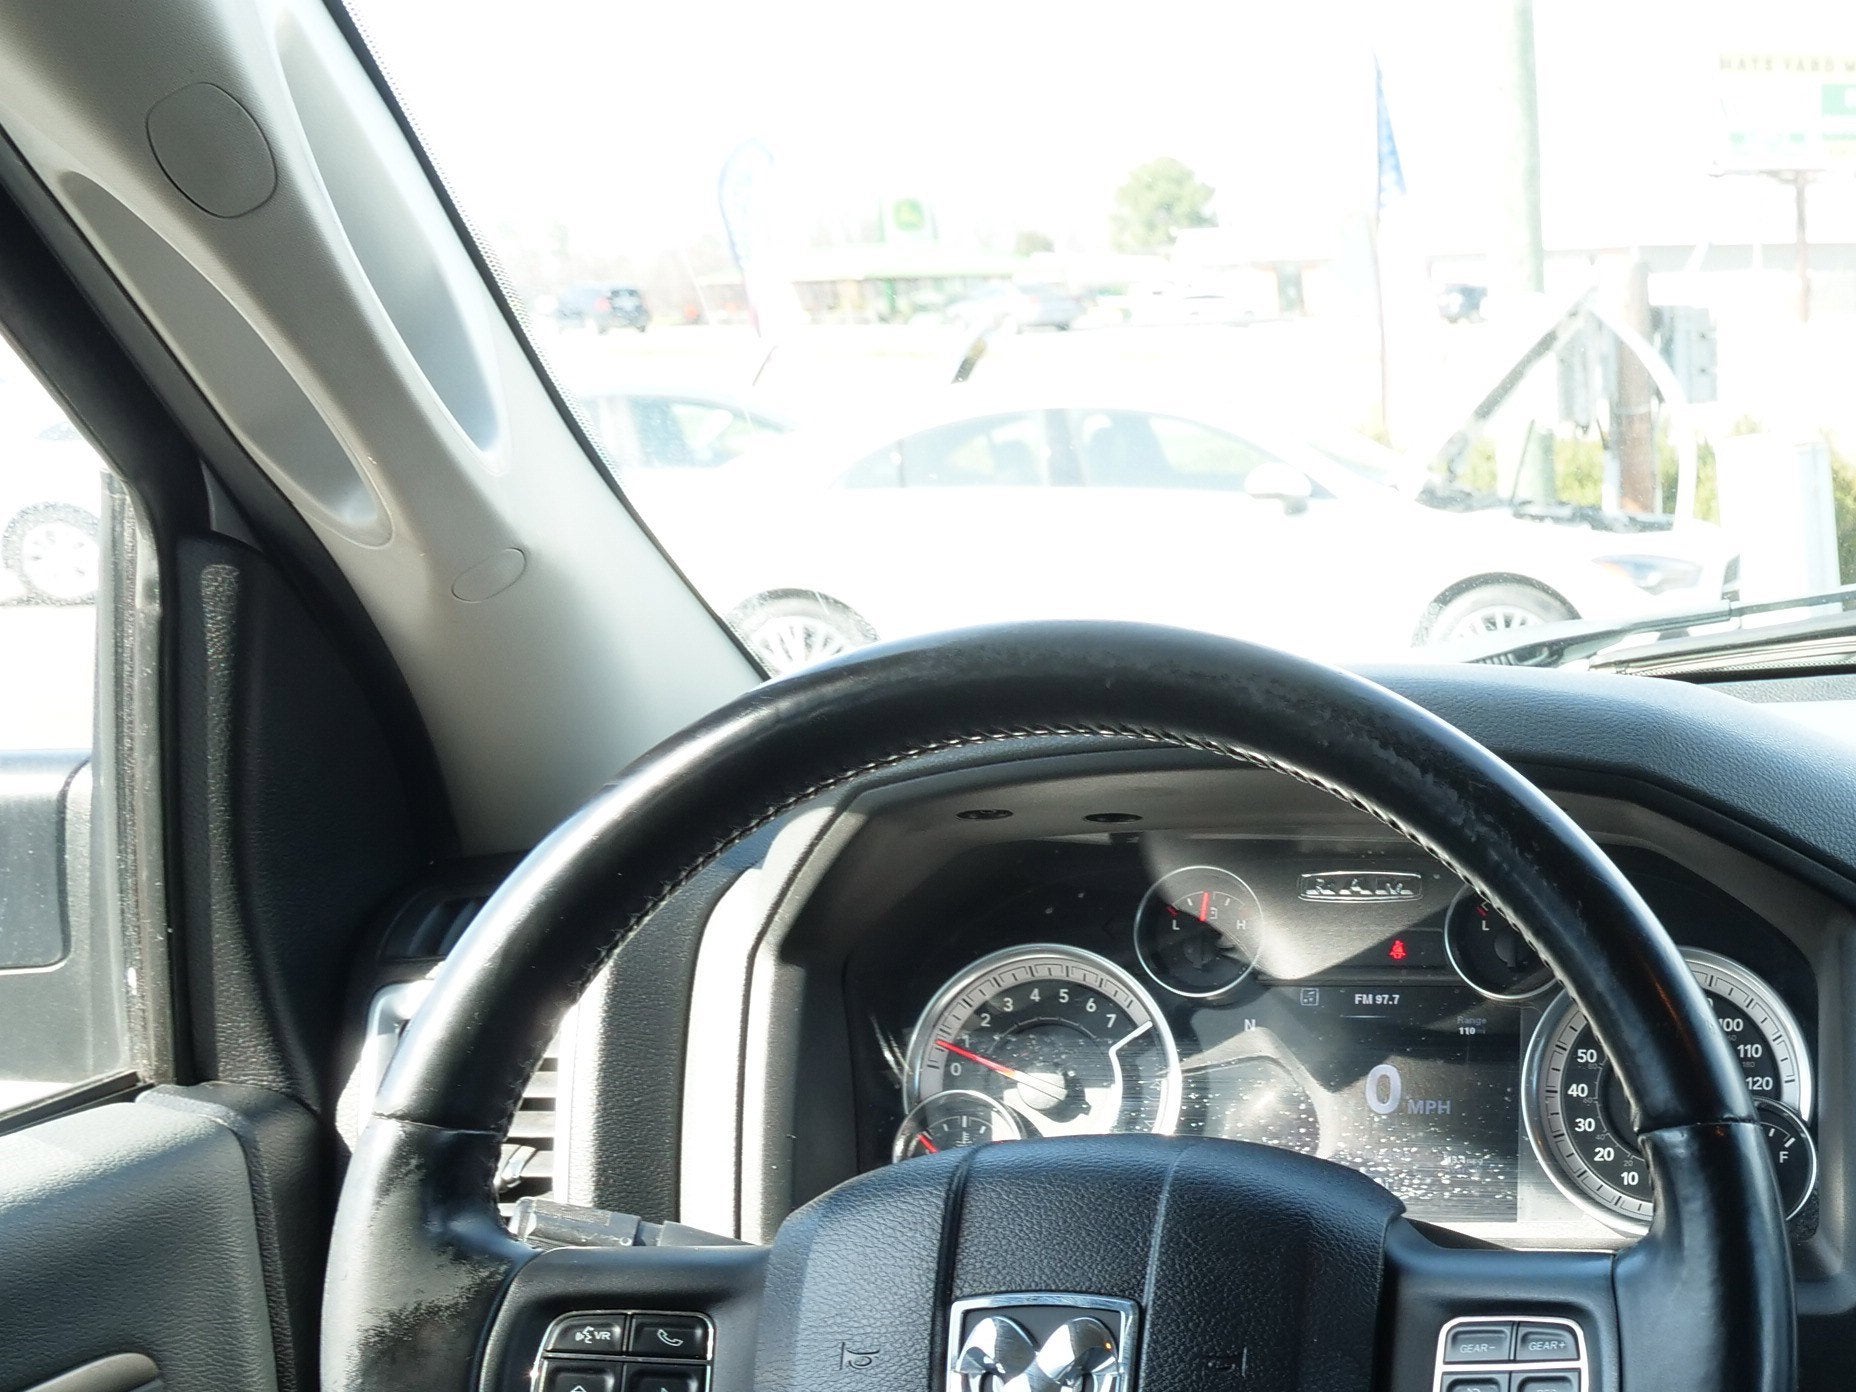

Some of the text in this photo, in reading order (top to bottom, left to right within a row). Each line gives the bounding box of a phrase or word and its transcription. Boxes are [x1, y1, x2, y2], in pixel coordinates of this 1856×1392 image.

[1172, 920, 1180, 930] L
[1236, 920, 1246, 930] H
[1482, 920, 1489, 931] L
[1030, 988, 1041, 1002] 4
[1058, 988, 1069, 1003] 5
[1355, 994, 1400, 1004] FM 97.7
[1003, 998, 1013, 1011] 3
[1086, 998, 1097, 1012] 6
[980, 1013, 991, 1027] 2
[1106, 1014, 1117, 1028] 7
[1244, 1019, 1256, 1031] N
[1457, 1016, 1487, 1026] Range
[1459, 1027, 1476, 1035] 110
[962, 1034, 970, 1046] 1
[1577, 1049, 1597, 1063] 50
[1737, 1044, 1762, 1058] 110
[951, 1063, 962, 1076] 0
[1365, 1064, 1453, 1115] 0 MPH
[1567, 1084, 1589, 1098] 40
[1745, 1077, 1773, 1091] 120
[1575, 1118, 1595, 1132] 30
[1594, 1147, 1615, 1162] 20
[1779, 1152, 1789, 1163] F
[1620, 1171, 1639, 1186] 10
[594, 1331, 611, 1340] VR
